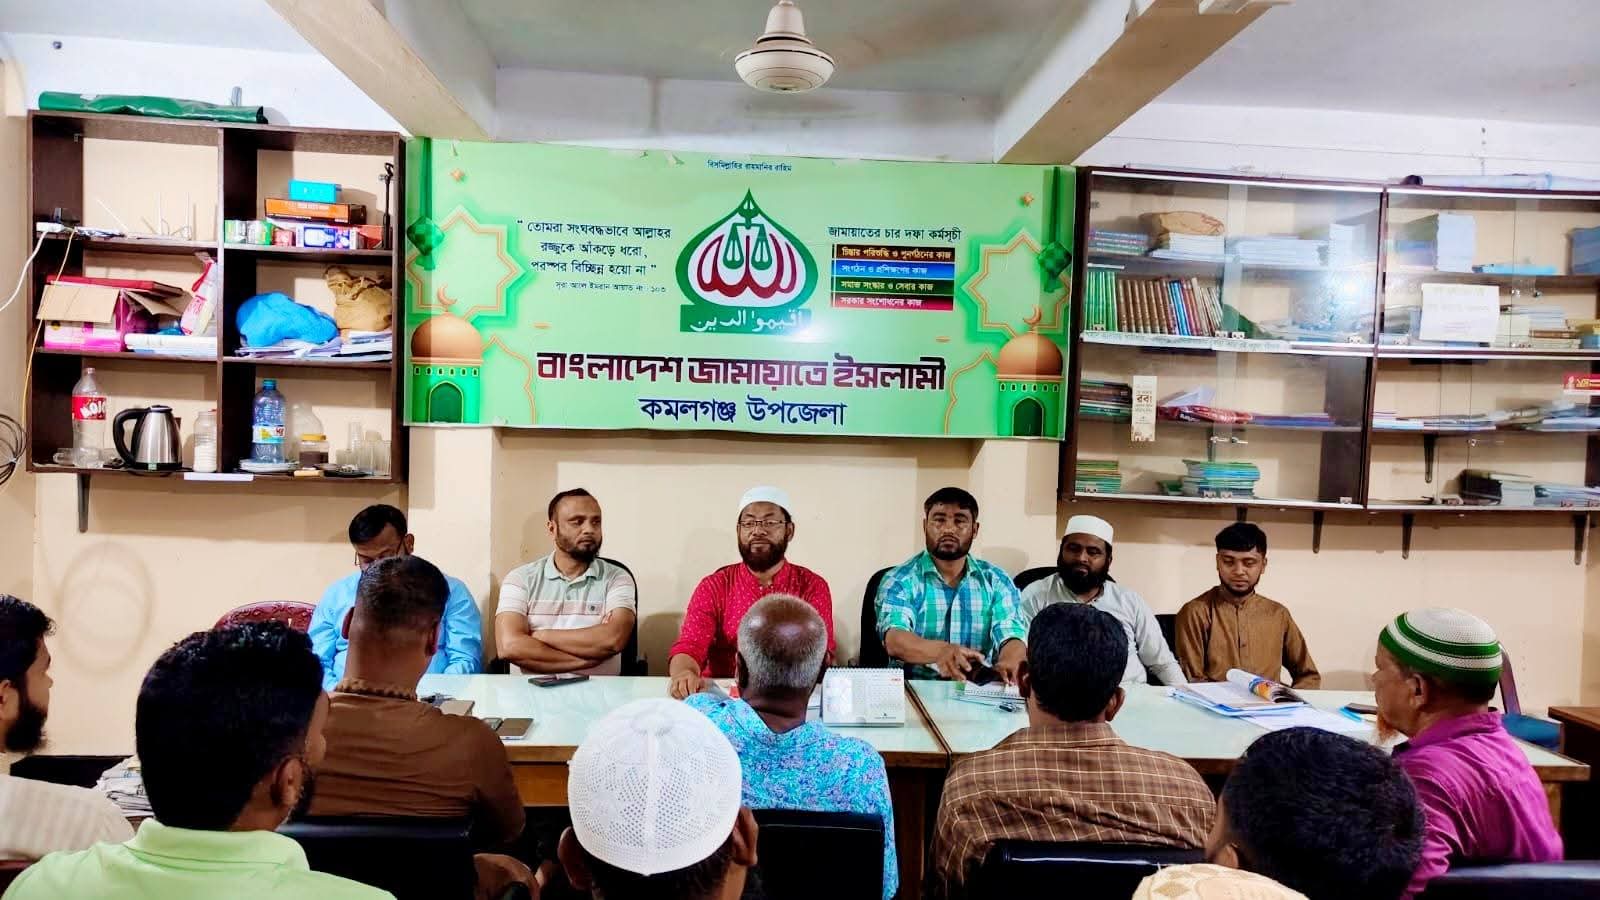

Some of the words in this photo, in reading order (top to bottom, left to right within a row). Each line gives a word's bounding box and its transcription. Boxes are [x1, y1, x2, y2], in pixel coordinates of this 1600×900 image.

[527, 222, 562, 234] তোমরা
[567, 223, 628, 237] সংঘবদ্ধভাবে
[633, 226, 671, 239] আল্লাহর
[828, 226, 881, 238] জামায়াতের
[884, 228, 900, 239] চার
[904, 229, 924, 240] দফা
[928, 227, 961, 243] কর্মসূচী
[541, 242, 575, 254] রজ্জুকে
[580, 241, 616, 258] আঁকড়ে
[936, 251, 952, 259] কাজ
[531, 260, 567, 273] পরস্পর
[571, 260, 604, 276] বিচ্ছিন্ন
[608, 263, 631, 275] হয়ো
[635, 265, 646, 275] না
[841, 264, 866, 273] সংগঠন
[918, 283, 934, 291] কাজ
[907, 298, 922, 307] কাজ
[537, 352, 683, 383] বাংলাদেশ
[688, 357, 829, 391] জামায়াতে
[833, 352, 947, 390] ইসলামী
[638, 397, 737, 423] কমলগঞ্জ
[746, 394, 847, 426] উপজেলা
